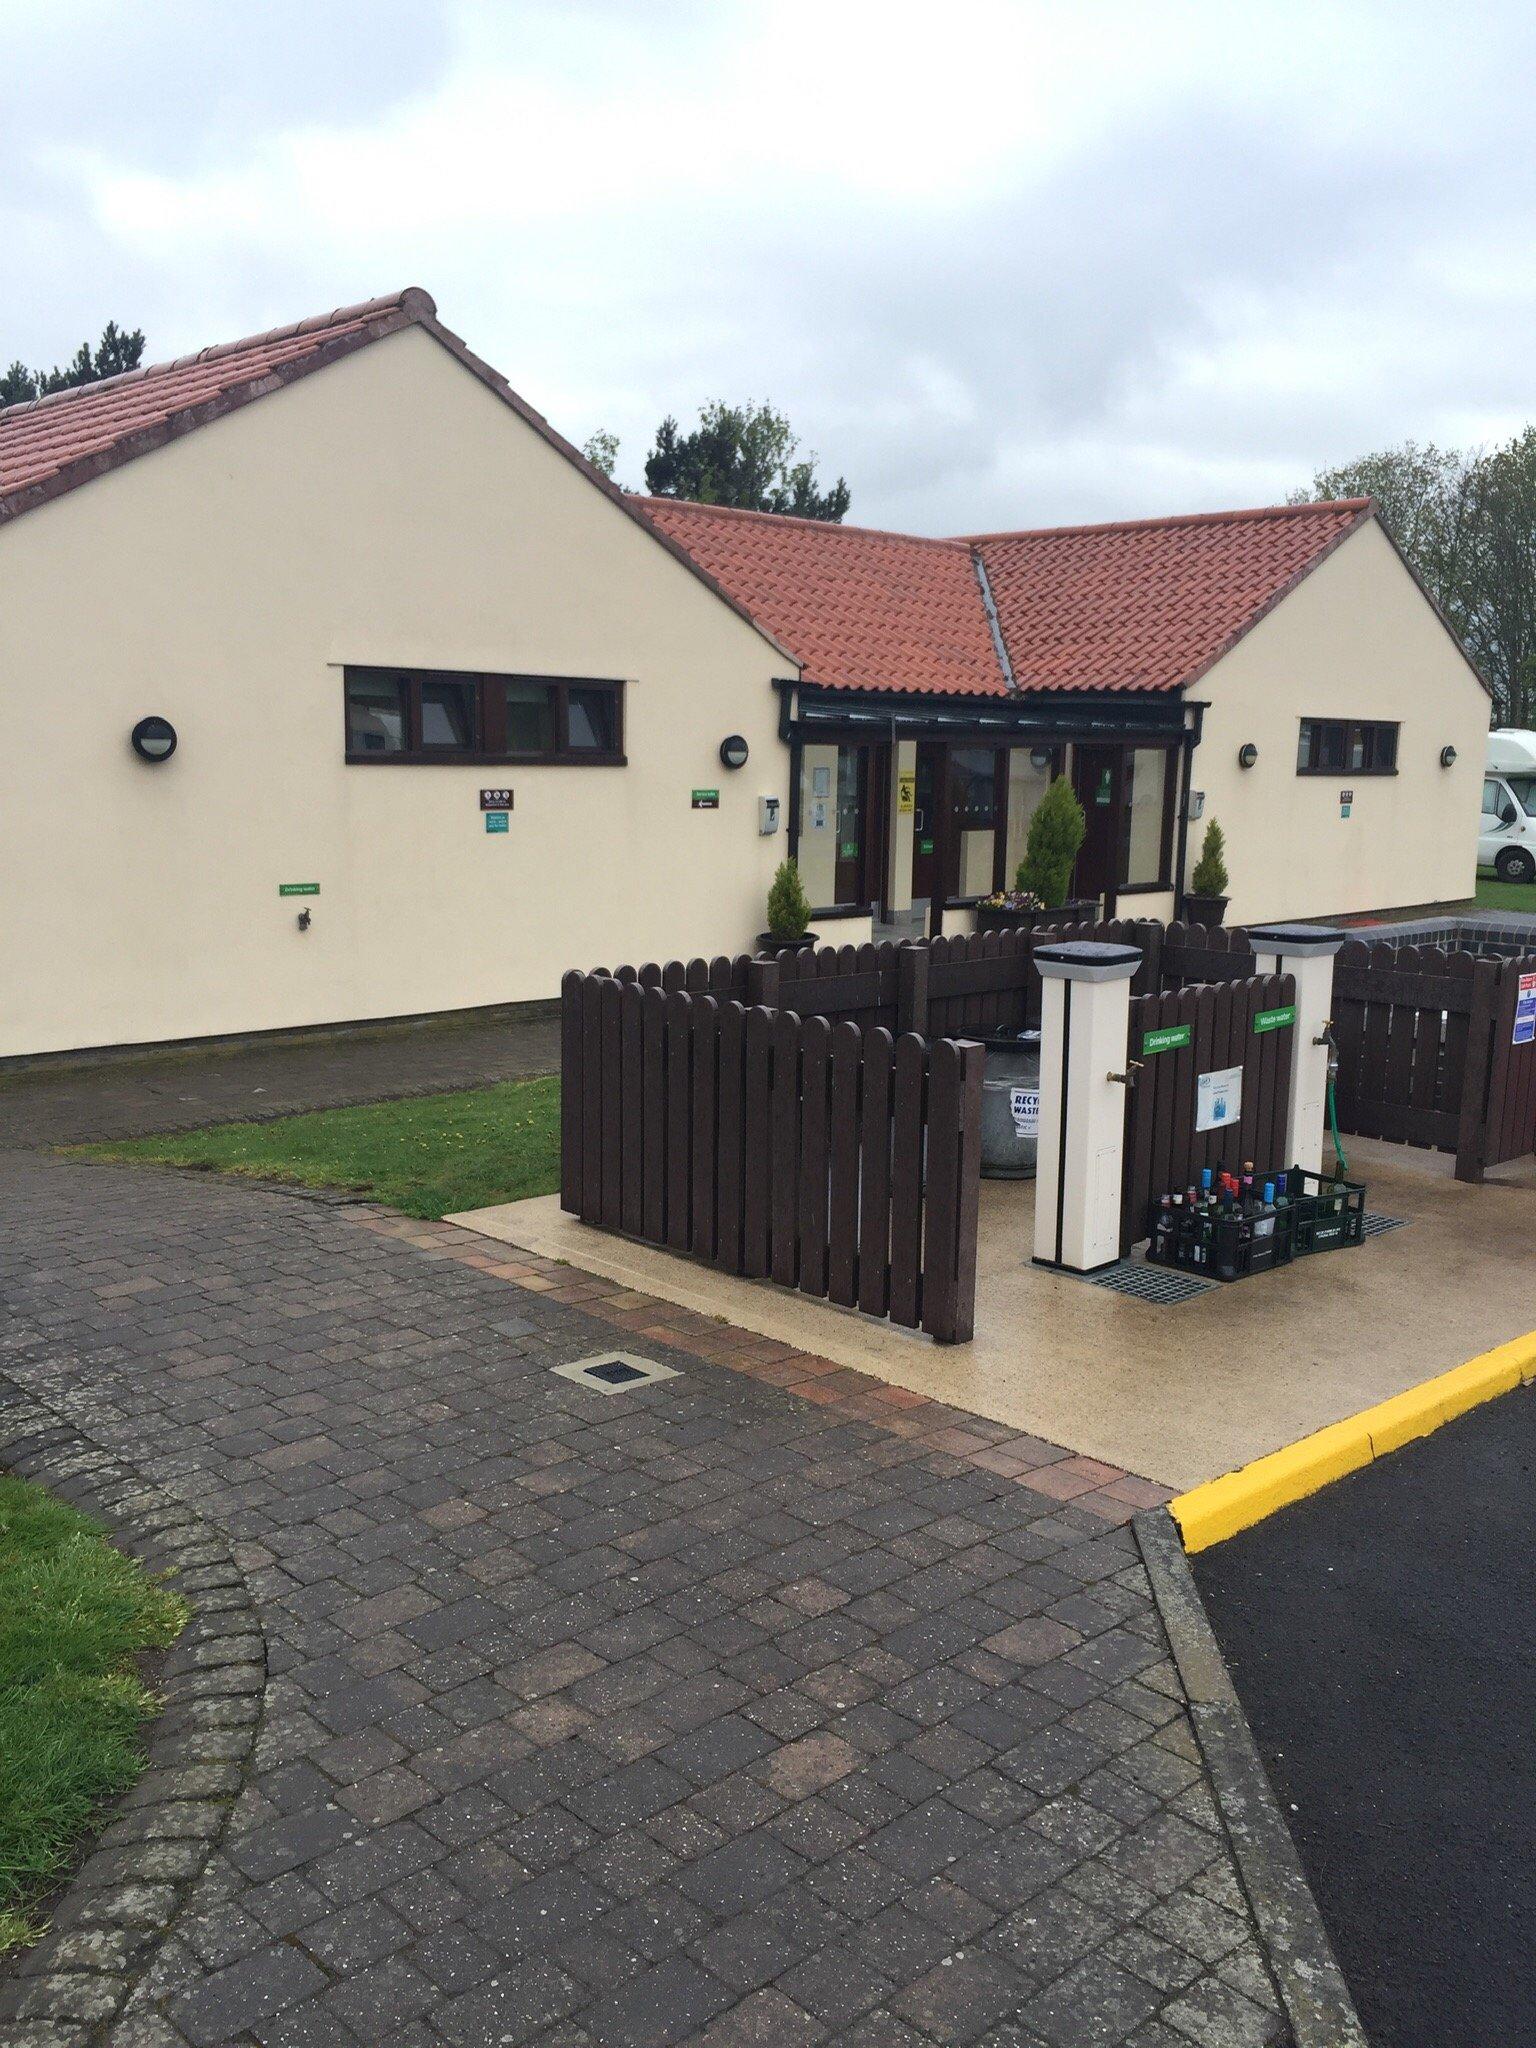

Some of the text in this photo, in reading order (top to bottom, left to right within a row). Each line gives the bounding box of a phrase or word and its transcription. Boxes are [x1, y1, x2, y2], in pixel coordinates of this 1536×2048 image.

[1260, 1012, 1291, 1026] Waste water
[1149, 1033, 1186, 1047] Drinking water
[1015, 1095, 1039, 1104] RECY
